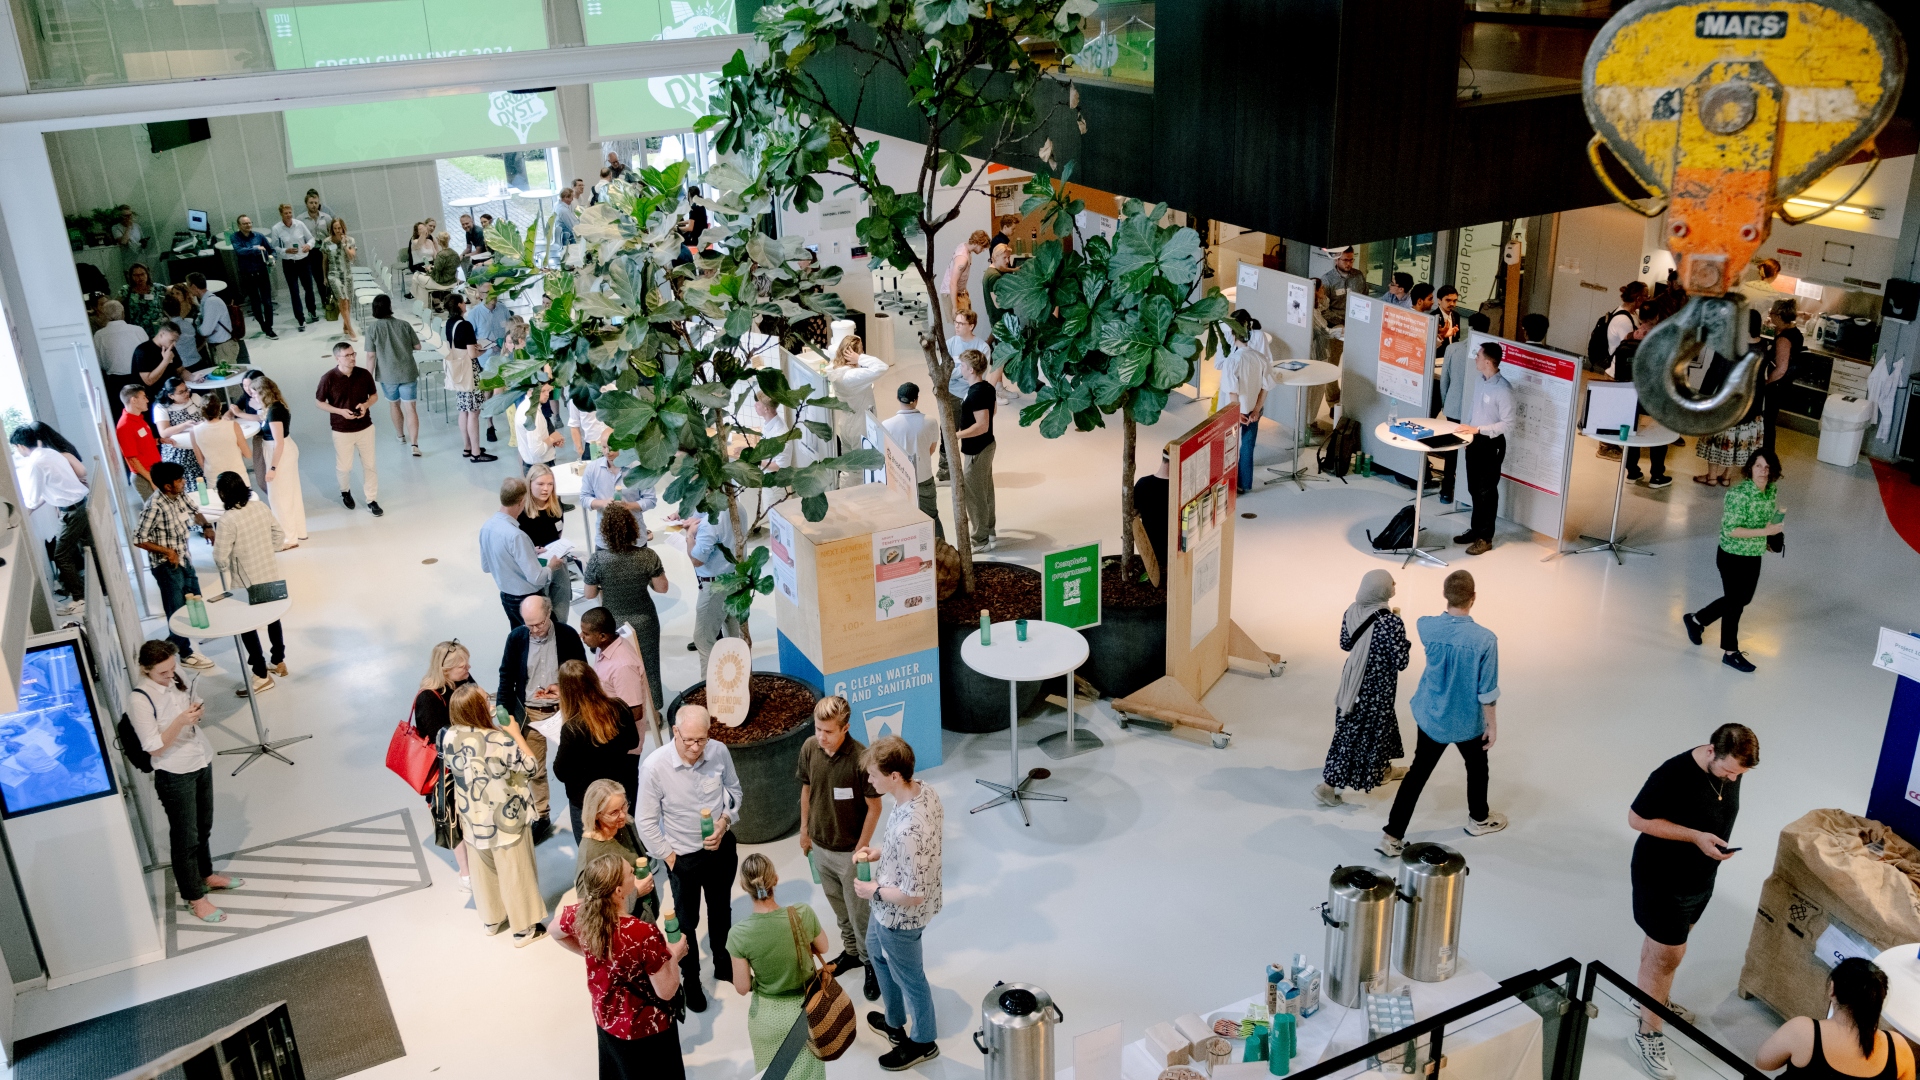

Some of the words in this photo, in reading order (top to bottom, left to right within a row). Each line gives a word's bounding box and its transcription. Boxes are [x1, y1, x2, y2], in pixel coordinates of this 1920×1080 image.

[274, 14, 290, 24] DTU
[1702, 13, 1780, 36] MARS
[496, 98, 534, 127] DYST
[1458, 261, 1471, 304] Rapid
[820, 549, 839, 558] NEXT
[849, 553, 870, 564] young
[1054, 556, 1088, 569] Complete
[1051, 566, 1092, 581] programme
[842, 621, 865, 632] 100+
[851, 672, 883, 691] CLEAN
[886, 662, 920, 681] WATER
[834, 681, 848, 701] 6
[852, 688, 872, 704] AND
[877, 672, 933, 697] SANITATION
[711, 695, 726, 704] LEAVE
[725, 696, 733, 704] NO
[732, 696, 742, 705] ONE
[717, 705, 735, 714] BEHIND
